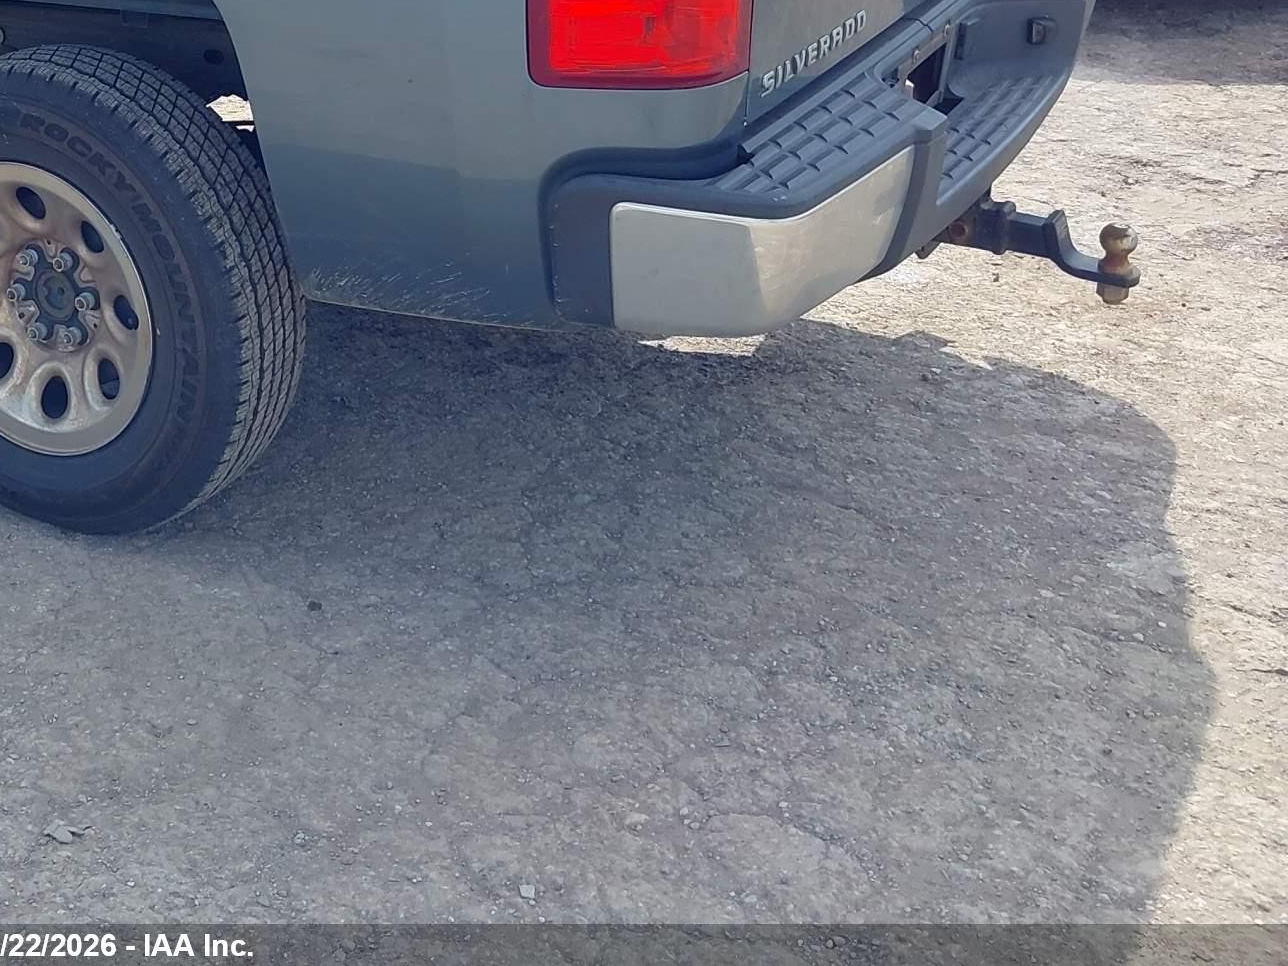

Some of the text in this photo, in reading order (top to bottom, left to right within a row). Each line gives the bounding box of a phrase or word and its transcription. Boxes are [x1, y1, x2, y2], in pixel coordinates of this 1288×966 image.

[760, 10, 866, 98] SILVERADO
[17, 112, 200, 422] ROCKY MOUNTAIN
